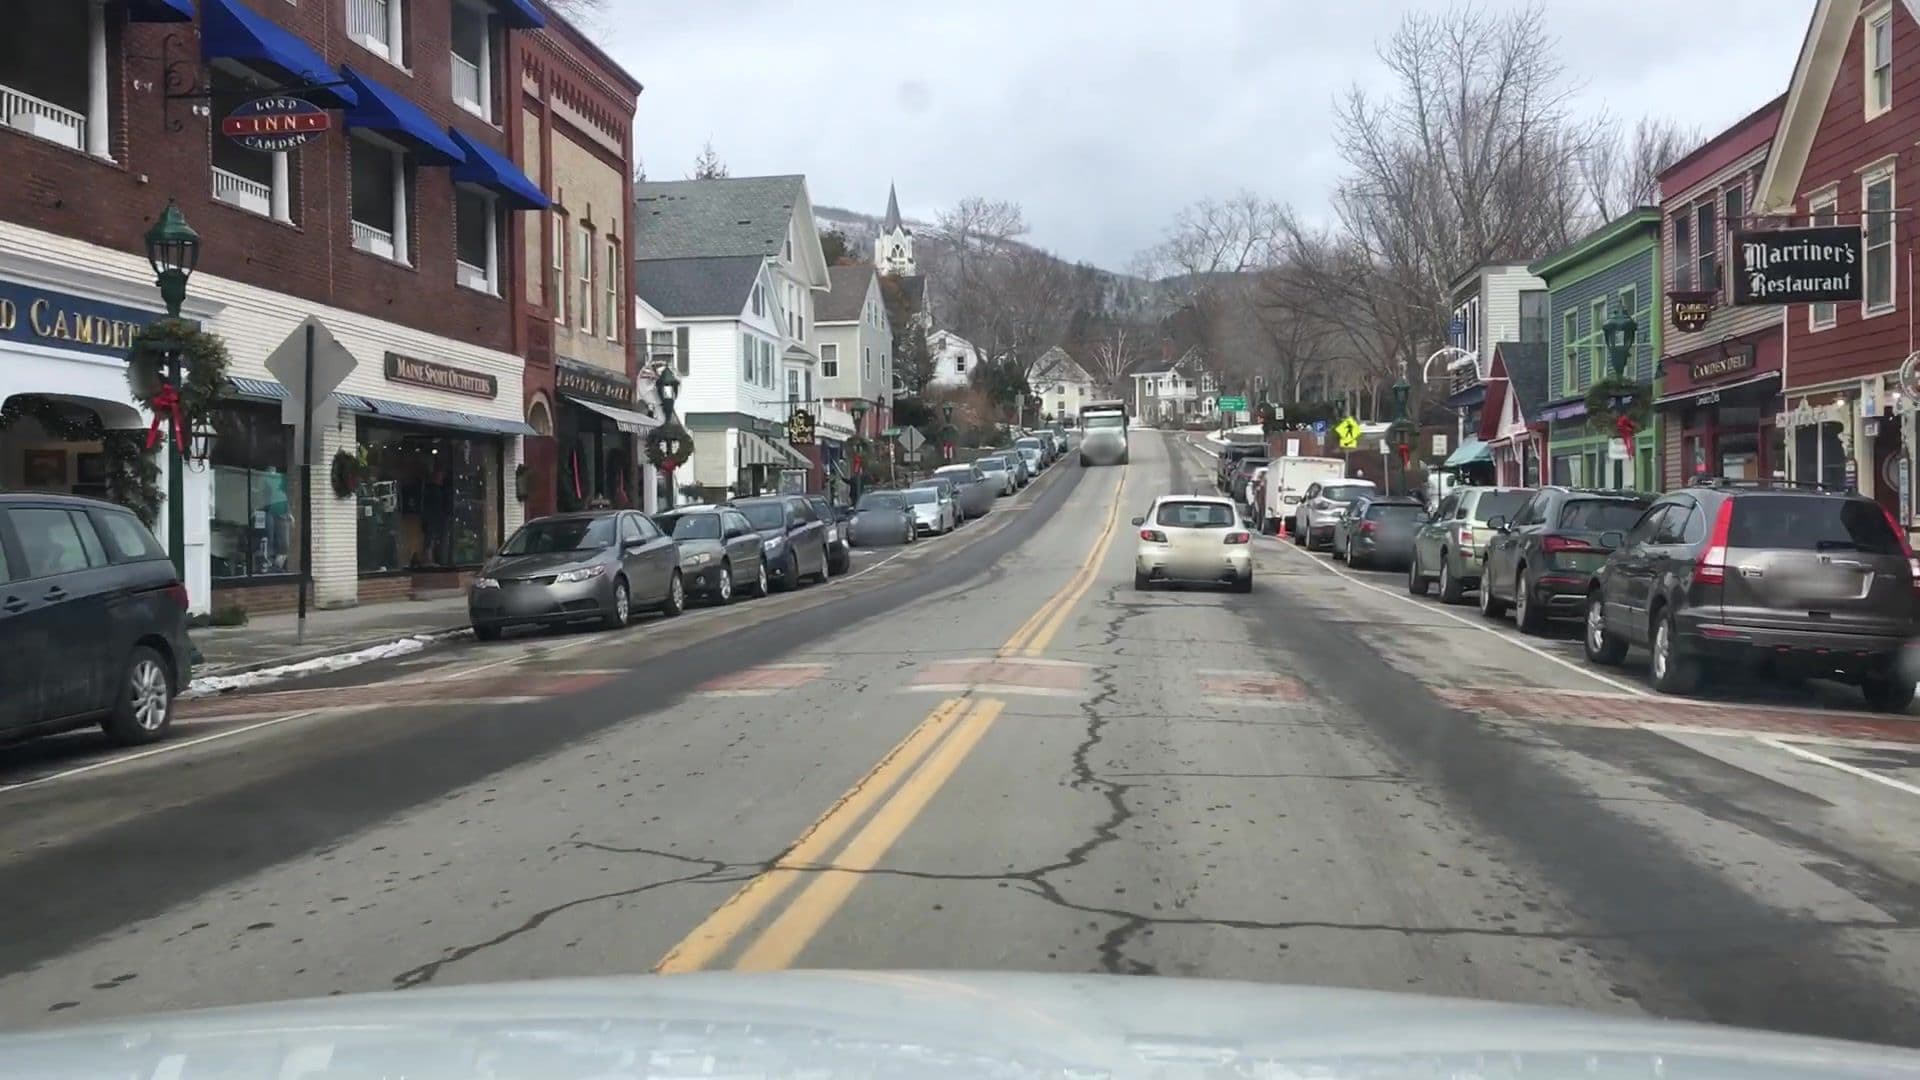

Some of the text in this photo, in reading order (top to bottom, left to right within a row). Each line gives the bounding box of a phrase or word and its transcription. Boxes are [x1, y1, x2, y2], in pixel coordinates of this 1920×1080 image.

[255, 99, 297, 111] LORD
[254, 115, 296, 131] INN
[245, 133, 307, 150] CAMDEN
[1742, 239, 1855, 272] Marriner's
[1748, 272, 1851, 297] Restaurant
[1727, 353, 1747, 371] DELI
[424, 363, 448, 387] SPORT
